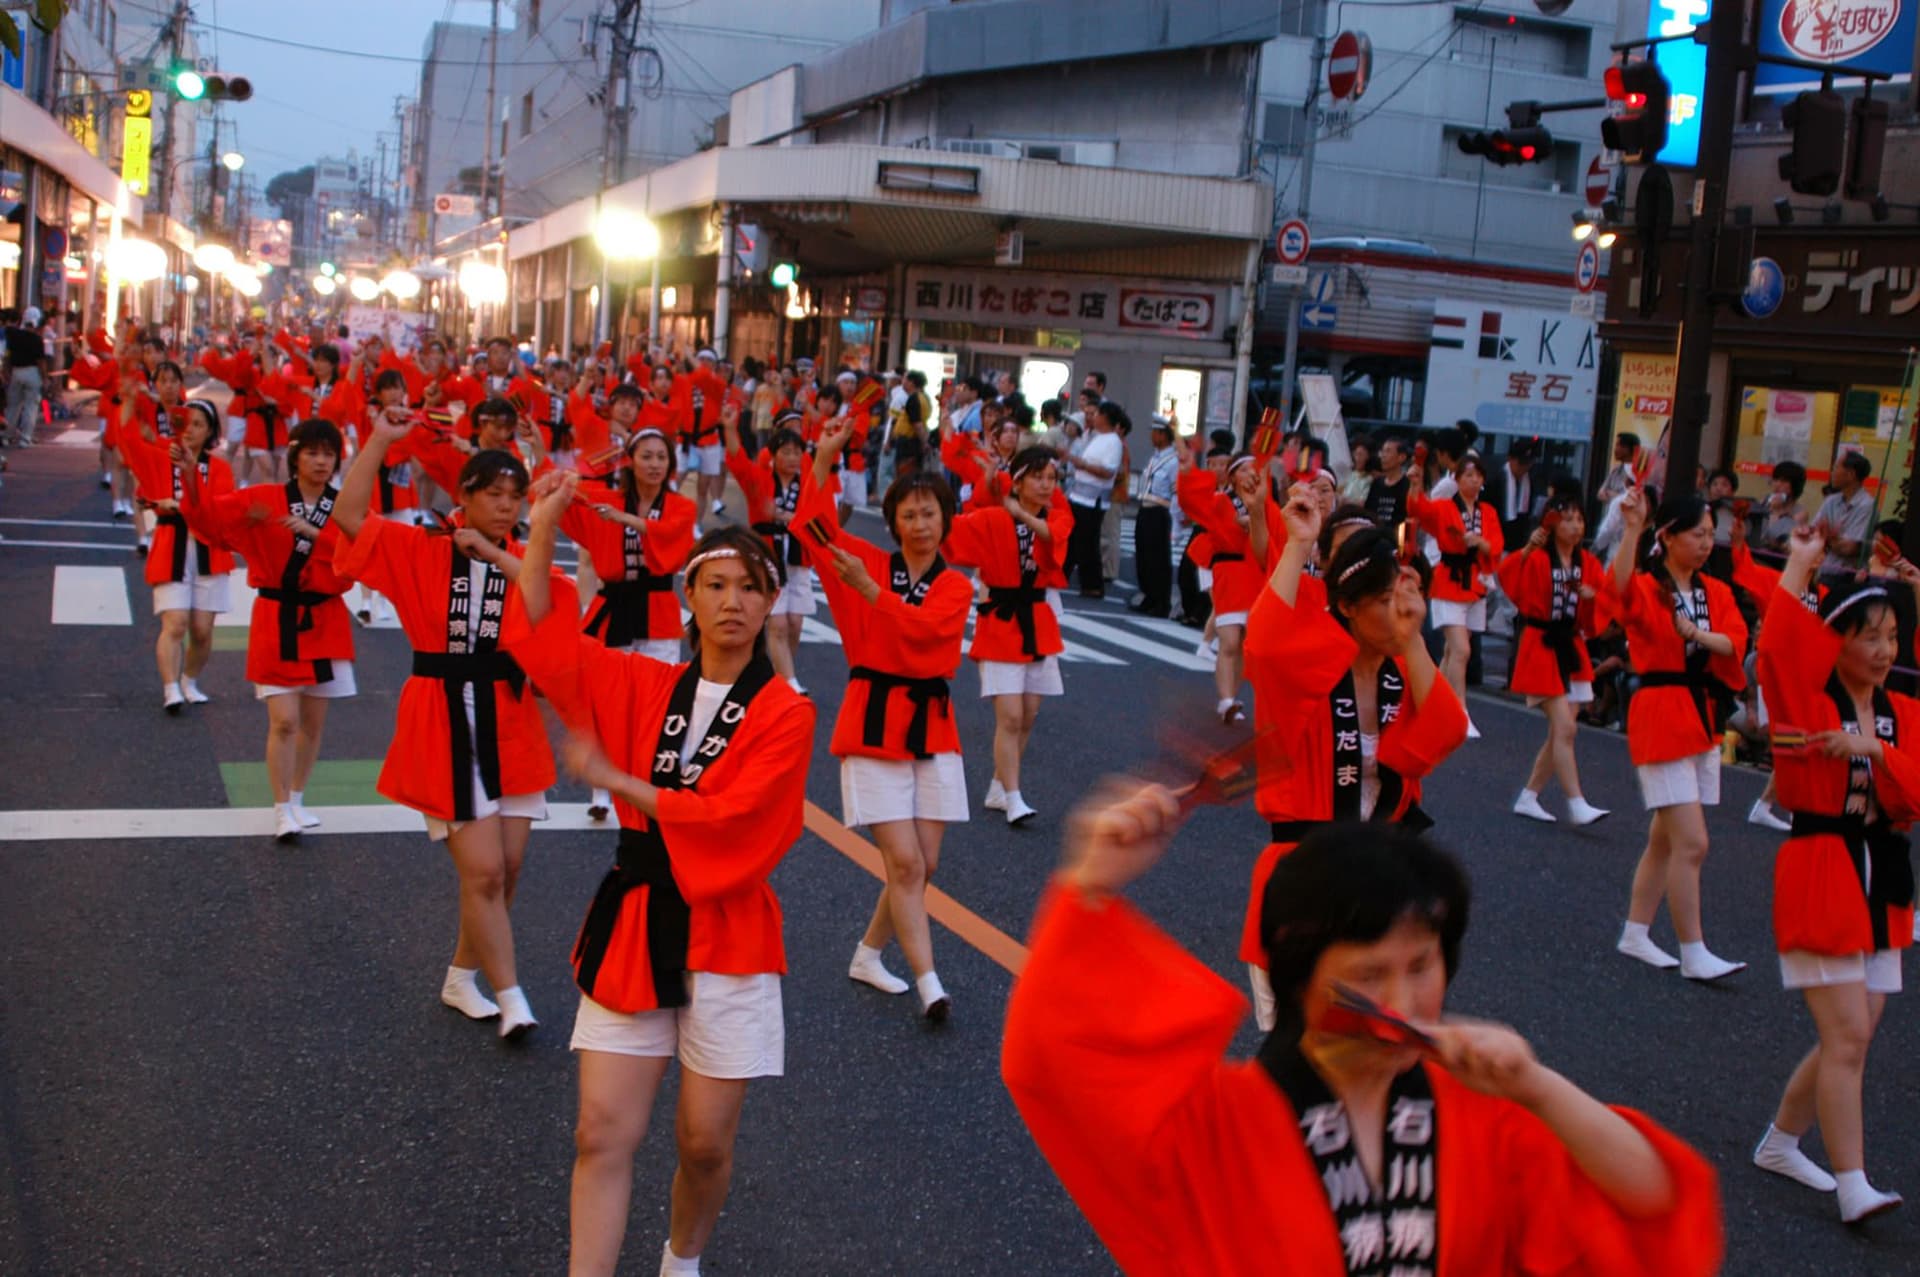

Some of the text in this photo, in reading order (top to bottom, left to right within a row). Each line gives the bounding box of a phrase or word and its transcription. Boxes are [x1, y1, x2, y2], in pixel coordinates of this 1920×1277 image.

[915, 280, 1108, 319] 西川たばこ店
[1132, 297, 1202, 324] たばこ
[448, 576, 470, 655] 石川病院
[653, 714, 688, 791] ひか
[680, 700, 747, 786] ひかり
[1335, 697, 1359, 787] こだま
